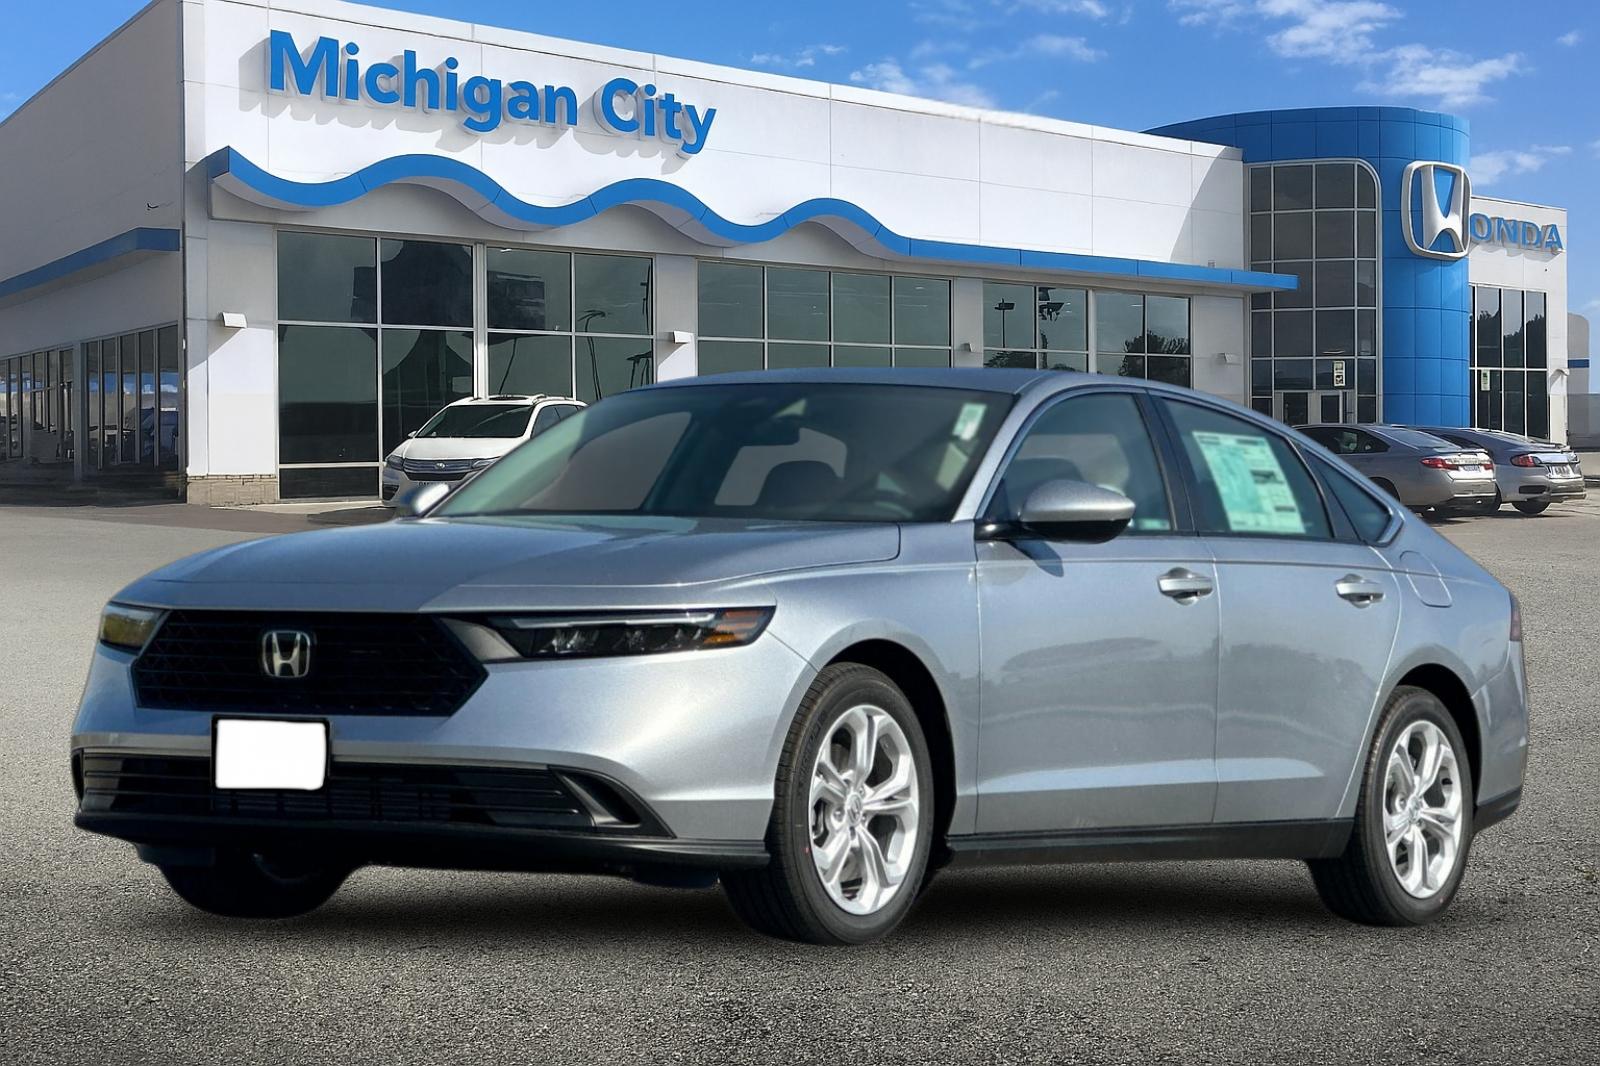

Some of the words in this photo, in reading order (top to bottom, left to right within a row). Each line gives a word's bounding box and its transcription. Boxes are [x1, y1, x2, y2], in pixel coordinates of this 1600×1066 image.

[269, 29, 578, 133] Michigan
[600, 76, 717, 155] City
[1469, 212, 1563, 250] ONDA
